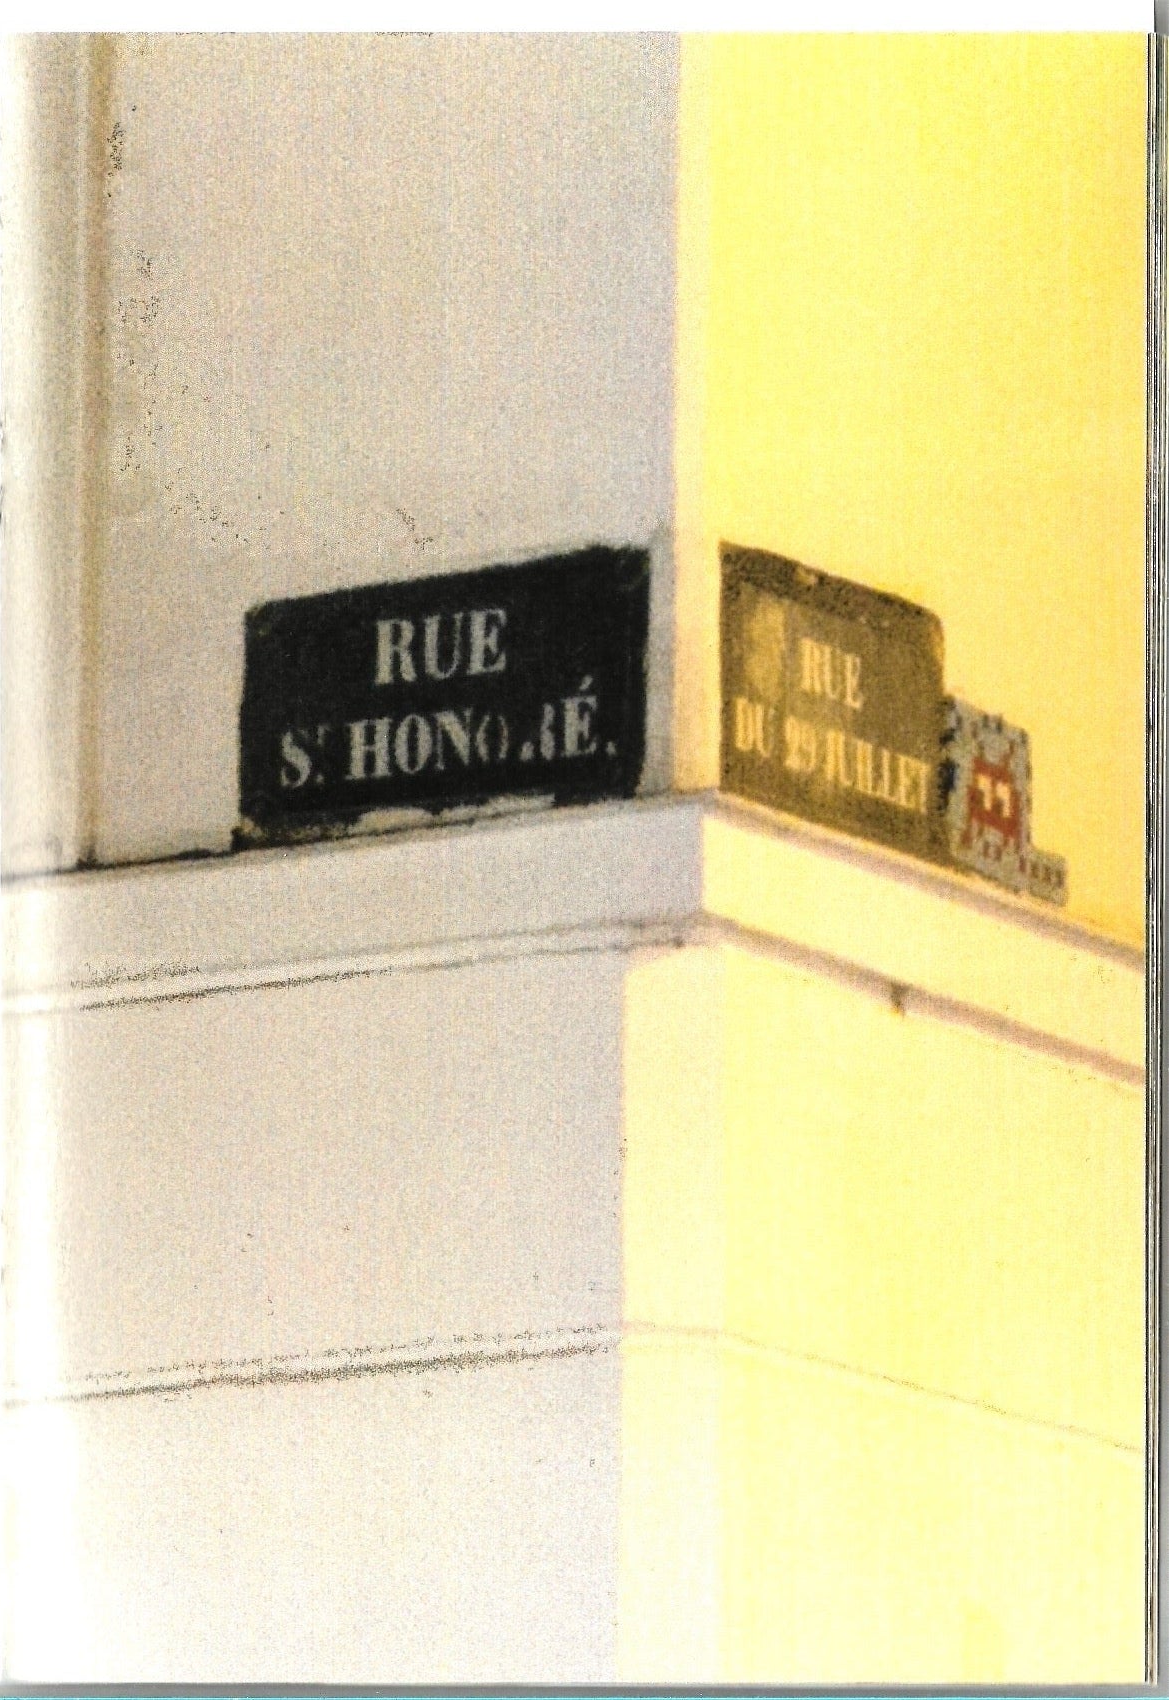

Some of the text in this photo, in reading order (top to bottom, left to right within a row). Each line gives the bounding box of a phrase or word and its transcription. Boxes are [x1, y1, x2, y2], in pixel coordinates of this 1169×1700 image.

[374, 608, 507, 686] RUE
[800, 638, 865, 710] RUE
[735, 696, 931, 815] DU 29 JUILLET
